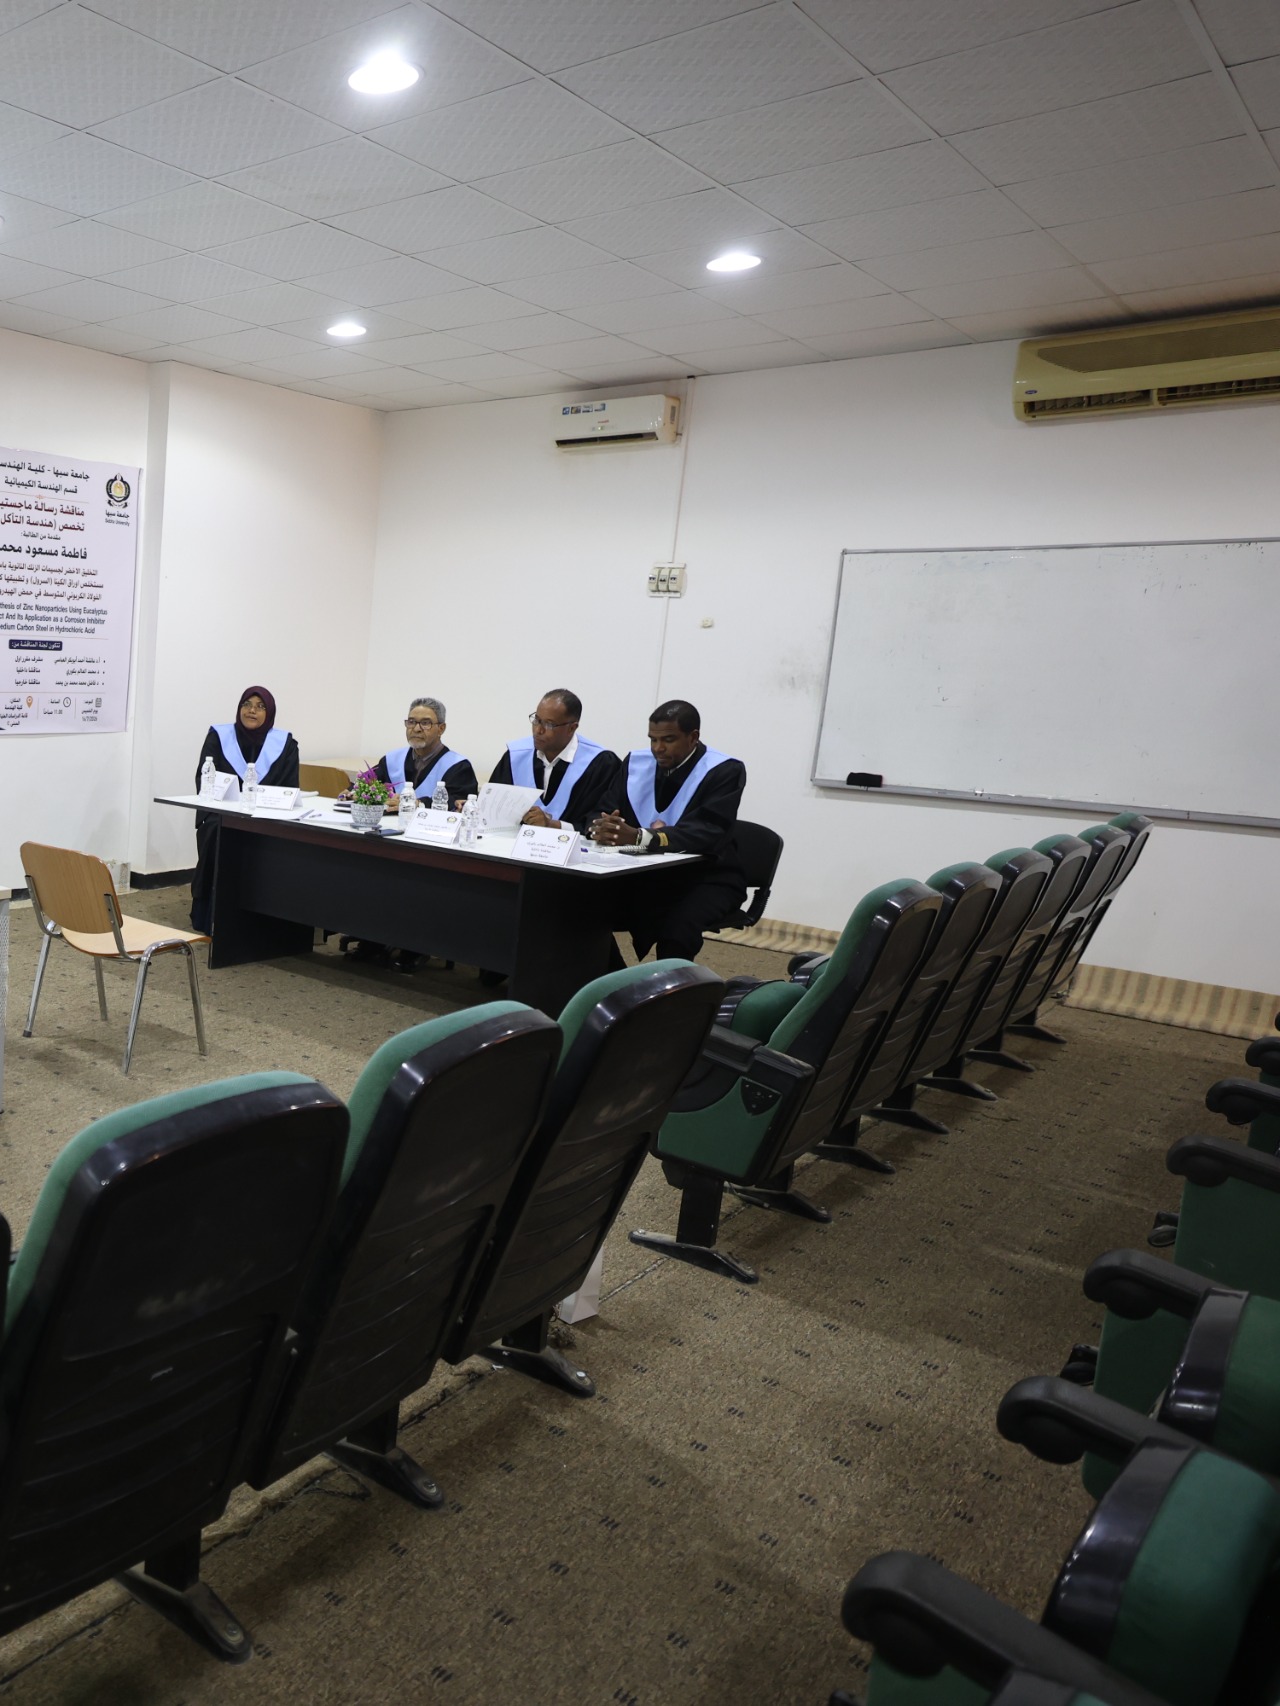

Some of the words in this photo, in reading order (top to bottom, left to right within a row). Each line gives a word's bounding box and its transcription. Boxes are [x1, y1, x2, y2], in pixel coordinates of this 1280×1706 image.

[27, 464, 45, 474] كلية
[52, 466, 69, 479] سبها
[71, 468, 90, 481] جامعة
[4, 476, 37, 489] الكيميائية
[38, 480, 62, 494] الهندسة
[64, 485, 78, 494] قسم
[34, 501, 58, 516] رسالة
[59, 506, 84, 517] مناقشة
[105, 510, 116, 518] سبها
[116, 511, 130, 519] جامعة
[26, 516, 57, 531] (هندسة
[59, 522, 85, 532] تخصص
[25, 545, 59, 559] مسعود
[61, 545, 88, 560] فاطمة
[26, 564, 40, 573] الزنك
[81, 569, 98, 578] التخليق
[54, 579, 67, 588] الكينا
[80, 581, 104, 589] مستخلص
[18, 590, 33, 598] حمض
[35, 591, 42, 600] في
[43, 589, 66, 600] المتوسط
[67, 592, 86, 602] الكربوني
[87, 593, 102, 602] الفولاذ
[35, 604, 68, 614] Nanoparticles
[69, 606, 82, 615] Using
[83, 607, 108, 616] Eucalyptus
[5, 612, 16, 620] And
[24, 614, 52, 623] Application
[64, 616, 86, 624] Corrosion
[86, 617, 106, 625] Inhibitor
[17, 623, 35, 631] Carbon
[36, 624, 48, 632] Steel
[55, 625, 83, 634] Hydrochloric
[84, 626, 95, 634] Acid
